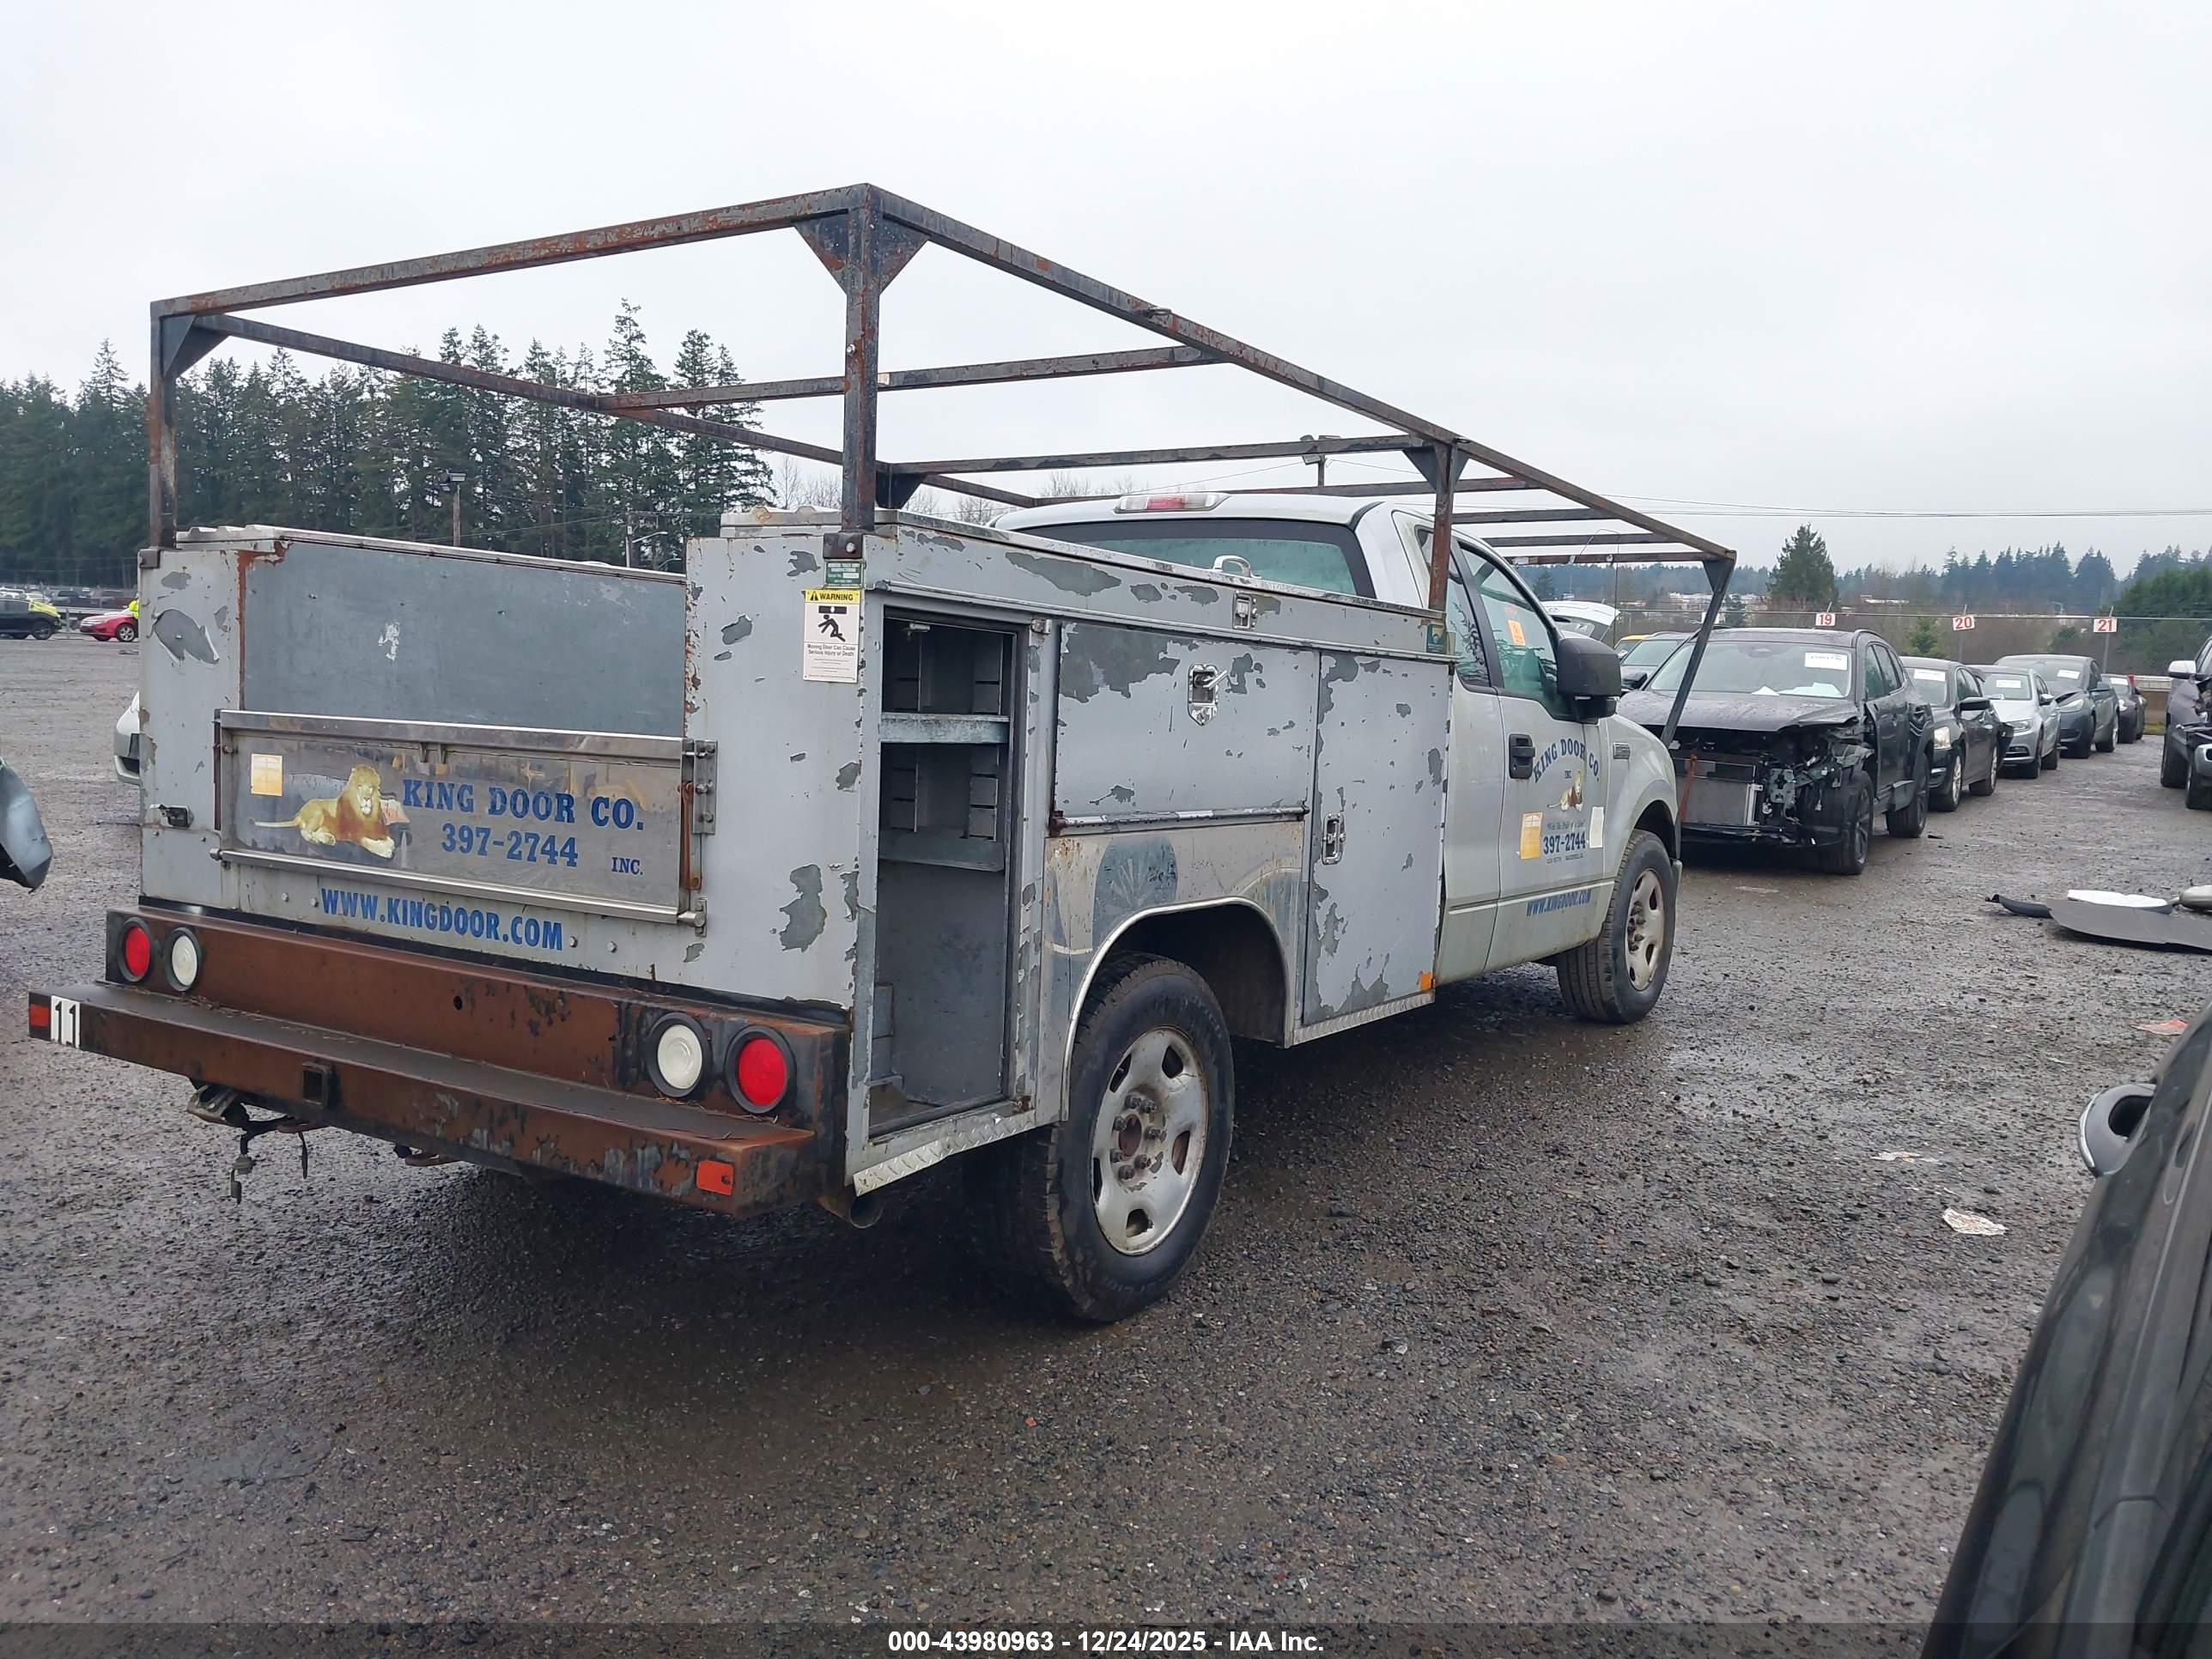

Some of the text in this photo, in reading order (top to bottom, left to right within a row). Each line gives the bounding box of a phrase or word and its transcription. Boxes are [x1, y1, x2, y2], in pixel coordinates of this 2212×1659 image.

[819, 592, 854, 601] WARNING
[1819, 613, 1833, 626] 19
[1954, 616, 1973, 630] 20
[2097, 618, 2114, 632] 21
[1532, 742, 1558, 784] KING
[1560, 738, 1586, 762] DOOR
[1589, 752, 1600, 782] CO.
[403, 779, 644, 831] KING DOOR CO.
[441, 823, 578, 867] 397-2744
[1543, 830, 1586, 855] 397-2744
[611, 857, 644, 876] INC.
[321, 888, 562, 951] WWW.KINGDOOR.COM
[55, 1000, 76, 1048] 11
